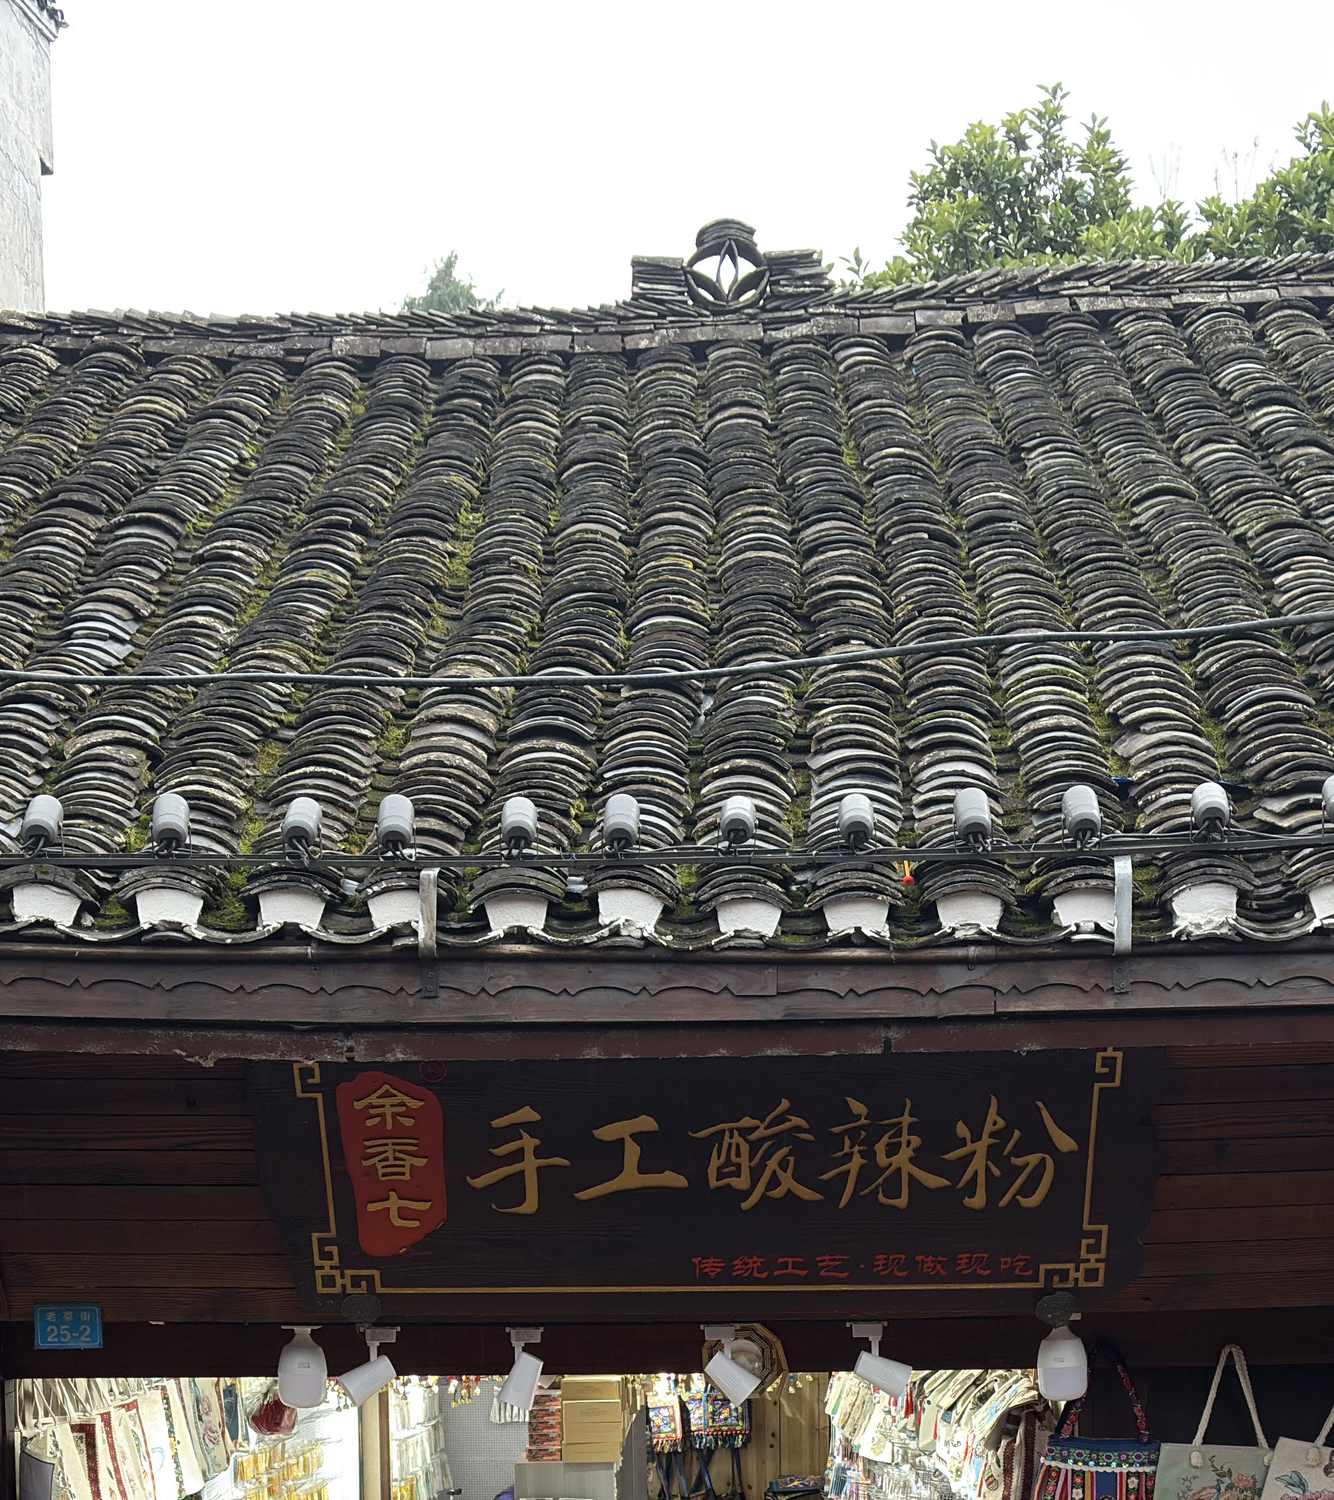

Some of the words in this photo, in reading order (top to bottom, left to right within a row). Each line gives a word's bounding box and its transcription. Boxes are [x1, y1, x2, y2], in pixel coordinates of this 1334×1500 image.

[466, 1095, 1079, 1214] 手工酸辣粉
[47, 1324, 91, 1342] 25-2
